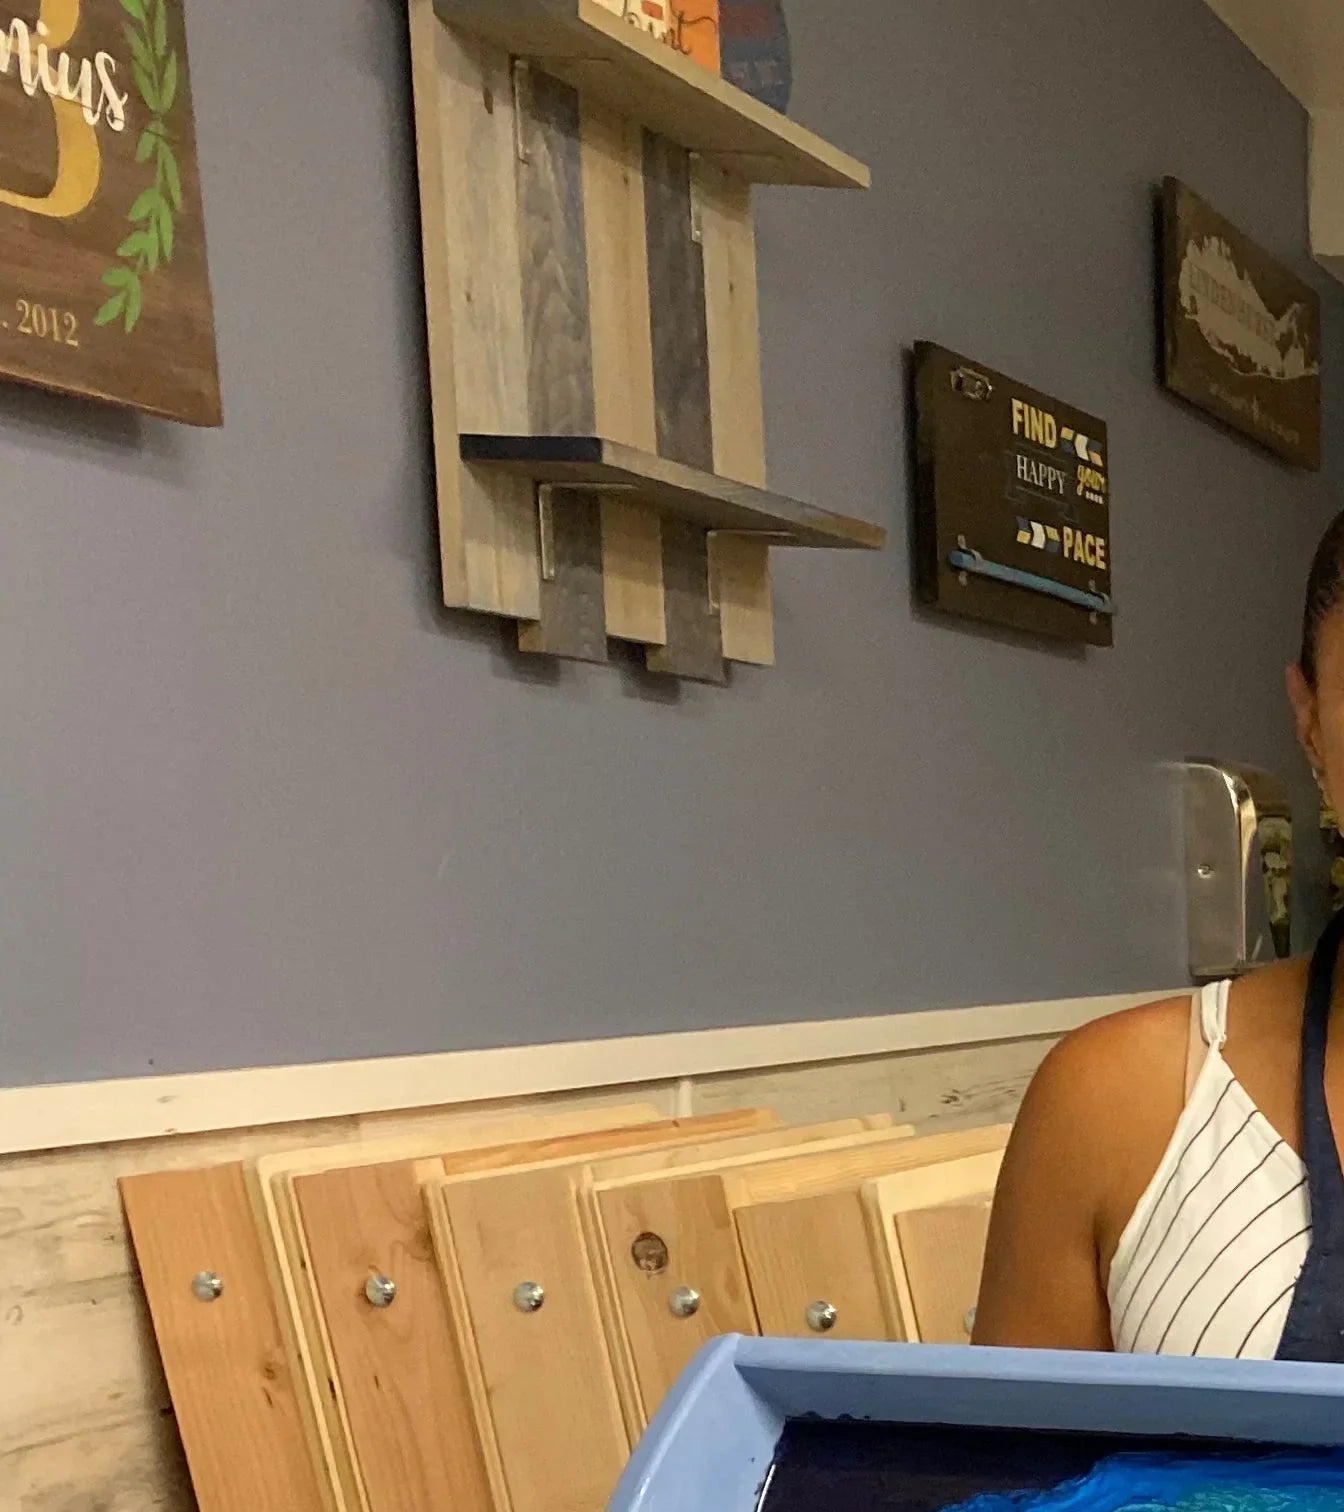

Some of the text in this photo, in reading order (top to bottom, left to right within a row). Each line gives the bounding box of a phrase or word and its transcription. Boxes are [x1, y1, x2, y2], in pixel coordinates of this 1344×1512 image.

[16, 299, 80, 347] 2012
[1011, 397, 1058, 449] FIND
[1016, 454, 1066, 495] HAPPY
[1062, 525, 1107, 570] PACE
